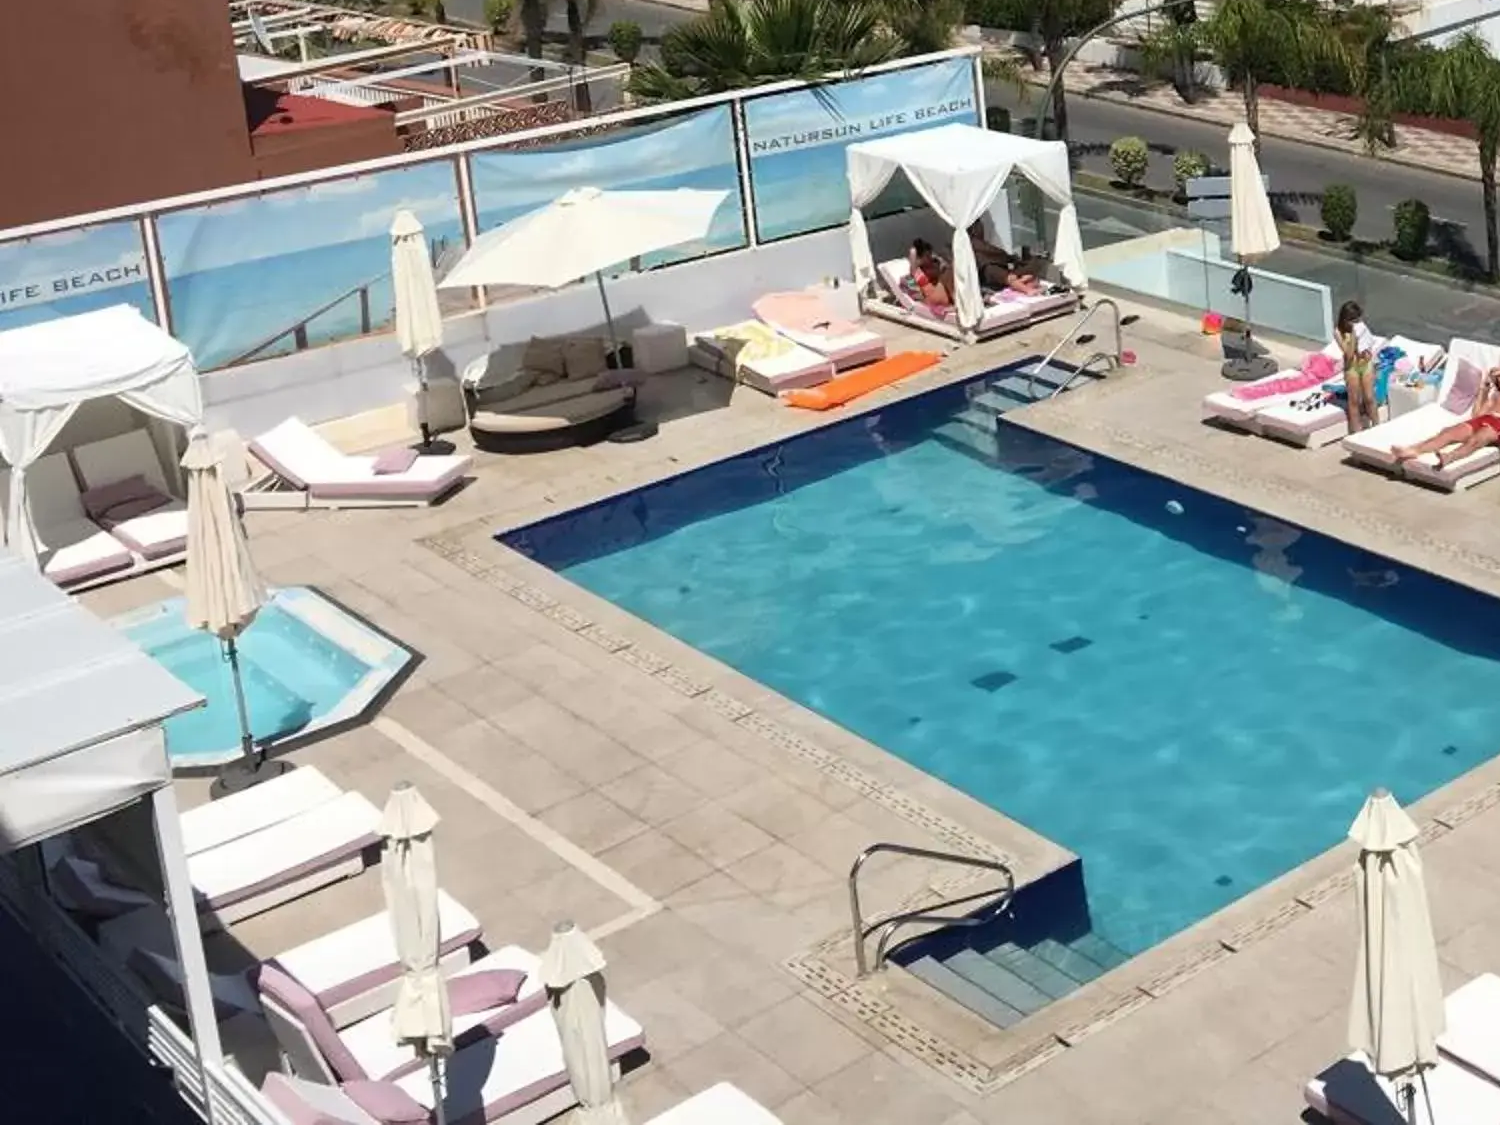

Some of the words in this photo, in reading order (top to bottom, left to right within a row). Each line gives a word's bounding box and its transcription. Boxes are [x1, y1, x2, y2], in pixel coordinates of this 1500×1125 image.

[752, 122, 861, 153] NATURSUN
[869, 112, 907, 130] LIFE
[914, 97, 972, 121] BEACH
[0, 284, 42, 304] IFE
[52, 263, 141, 292] BEACH
